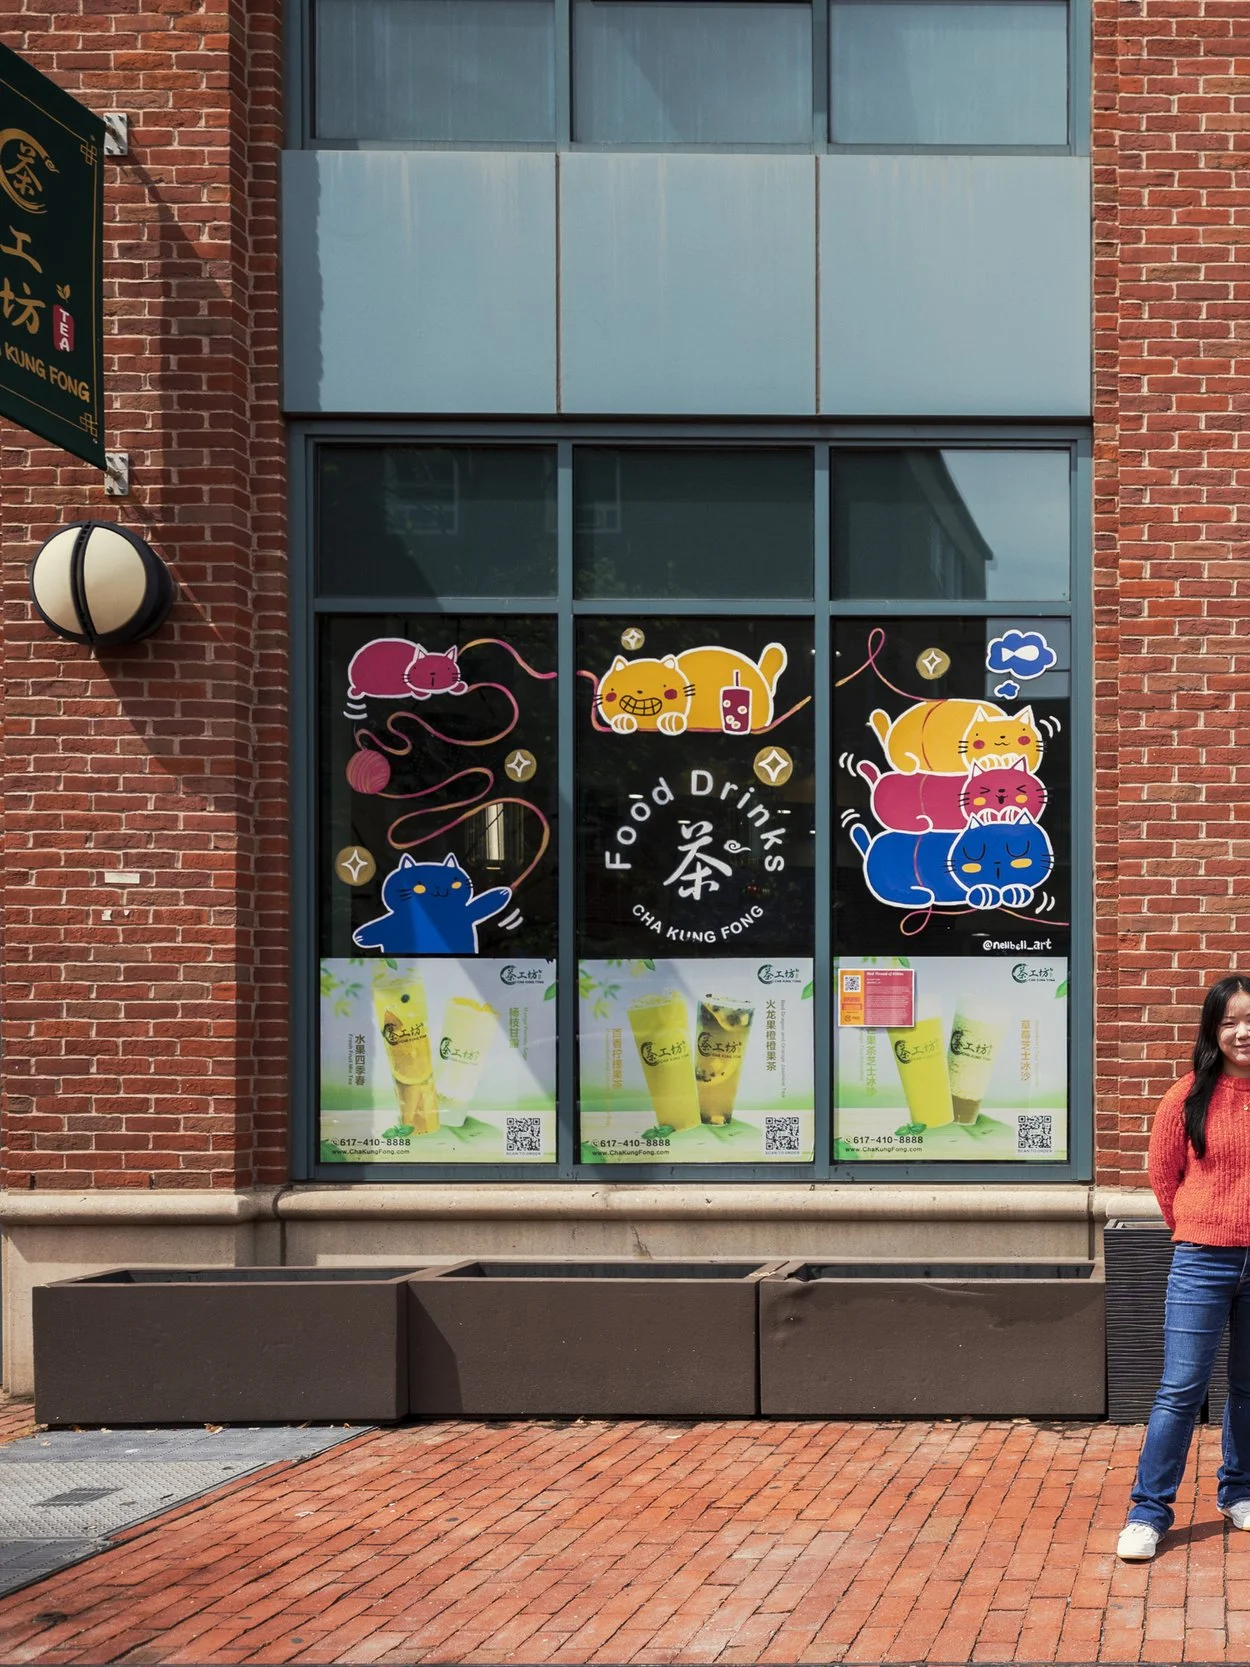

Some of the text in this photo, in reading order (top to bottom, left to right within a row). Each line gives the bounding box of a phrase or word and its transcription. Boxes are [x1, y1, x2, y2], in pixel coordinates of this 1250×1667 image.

[0, 142, 47, 335] 茶工坊
[59, 308, 71, 352] TEA
[5, 342, 90, 403] KUNG FONG
[605, 769, 786, 872] Food Drinks
[663, 820, 732, 901] 茶
[632, 904, 764, 943] CHA KUNG FONG
[355, 1034, 365, 1086] 水果四季春
[339, 1138, 411, 1147] 617-410-8888
[600, 1138, 671, 1147] 617-410-8888
[853, 1135, 924, 1144] 617-410-8888
